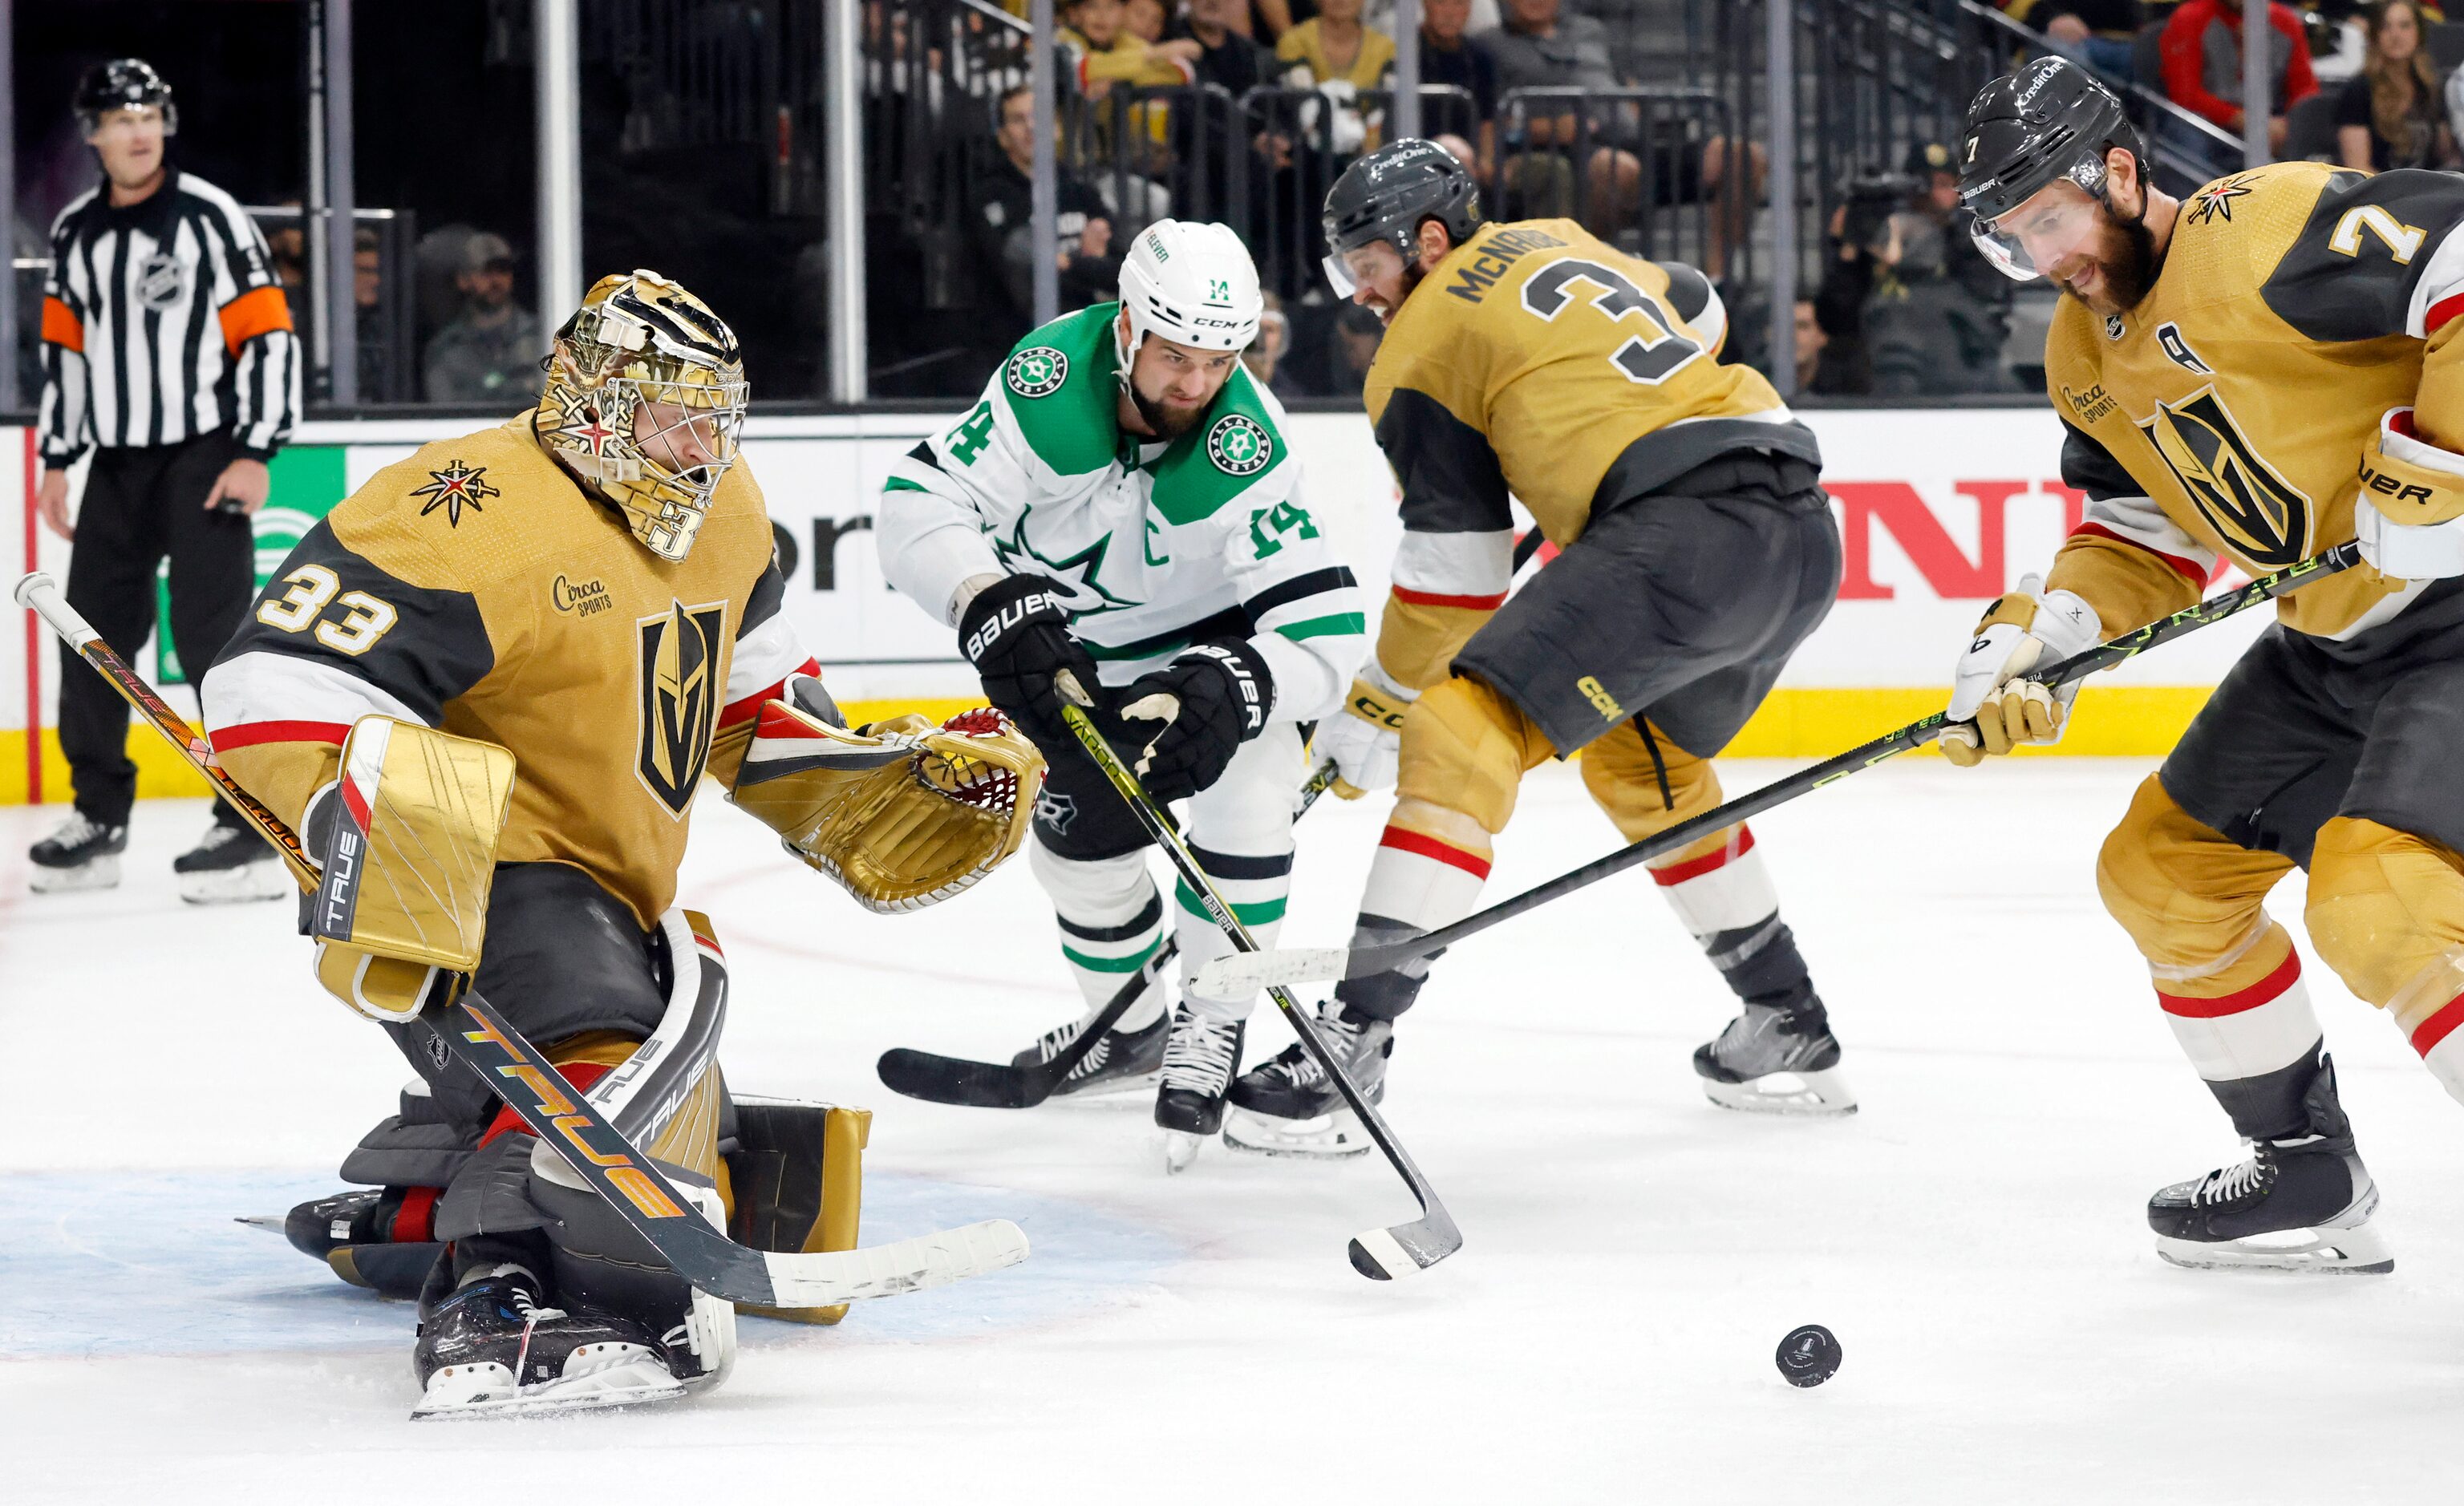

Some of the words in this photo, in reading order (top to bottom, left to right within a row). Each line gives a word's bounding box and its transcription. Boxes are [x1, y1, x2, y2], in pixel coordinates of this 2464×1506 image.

[1968, 136, 1980, 163] 7
[2329, 204, 2426, 265] 7
[1210, 279, 1230, 301] 14
[1194, 318, 1238, 330] CCM
[1521, 257, 1706, 385] 3
[2155, 321, 2216, 376] A
[946, 400, 994, 467] 4
[1211, 419, 1254, 458] DALLAS
[1231, 439, 1268, 472] STARS
[646, 501, 705, 560] 3
[1145, 519, 1169, 566] C
[1250, 500, 1320, 561] 14
[256, 564, 399, 656] 33
[553, 575, 605, 611] Circa
[578, 594, 612, 617] SPORTS
[103, 653, 168, 712] TRUE
[1577, 676, 1624, 722] CCM
[325, 831, 358, 933] TRUE
[591, 1038, 663, 1105] RUE
[459, 1002, 687, 1219] TRUE
